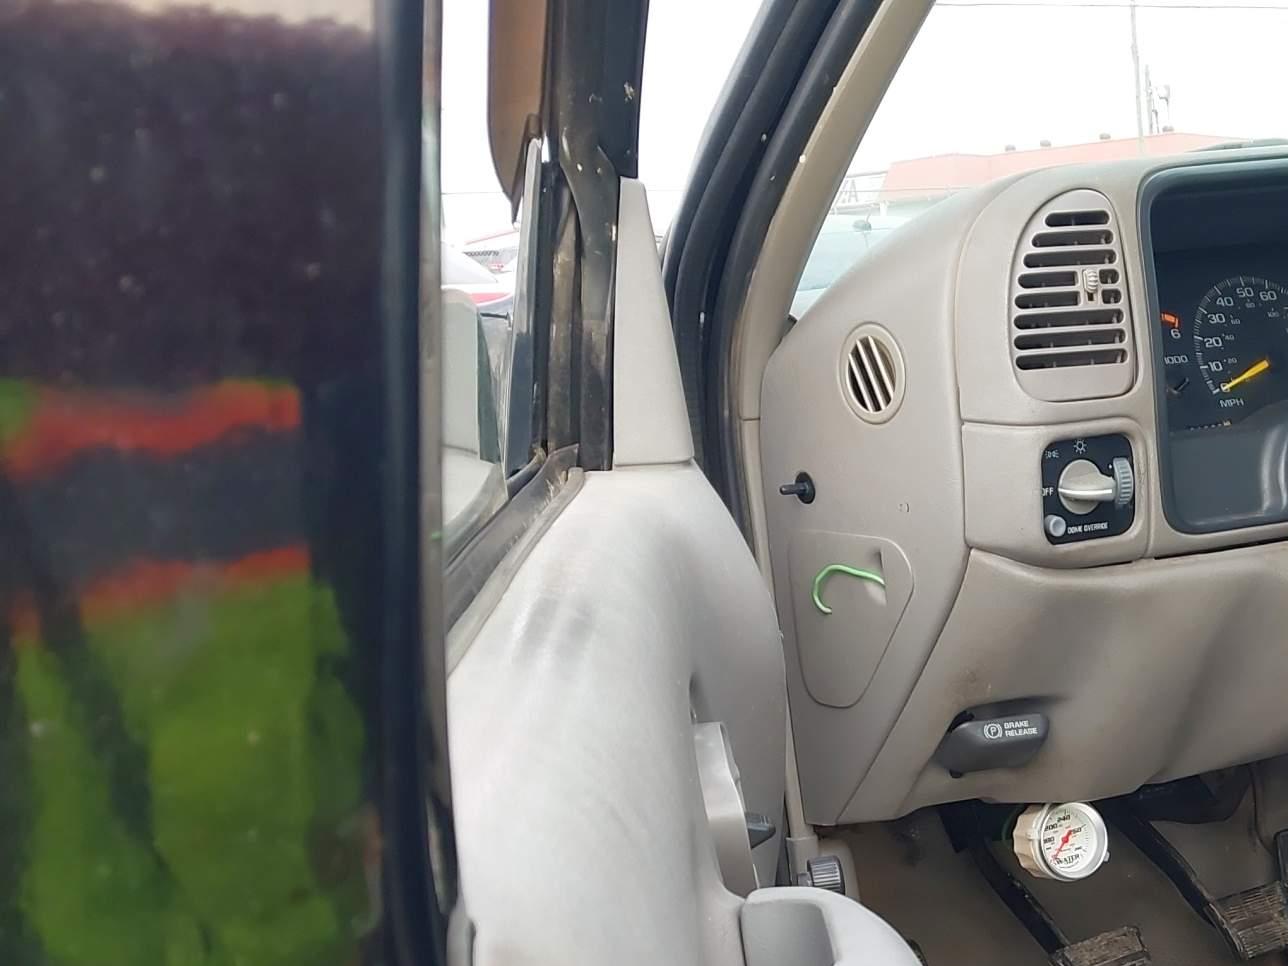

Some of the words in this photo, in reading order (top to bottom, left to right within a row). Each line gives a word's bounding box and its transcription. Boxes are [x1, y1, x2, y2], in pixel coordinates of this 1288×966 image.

[1236, 287, 1254, 298] 50
[1259, 290, 1277, 301] 60
[1216, 296, 1234, 307] 40
[1207, 313, 1226, 324] 30
[1170, 328, 1181, 339] 6
[1204, 337, 1222, 348] 20
[1164, 355, 1189, 365] 1000
[1208, 361, 1224, 372] 10
[1219, 397, 1245, 408] MPH
[1003, 720, 1029, 729] BRAKE
[1005, 727, 1038, 737] RELEASE
[1056, 853, 1080, 865] WATER
